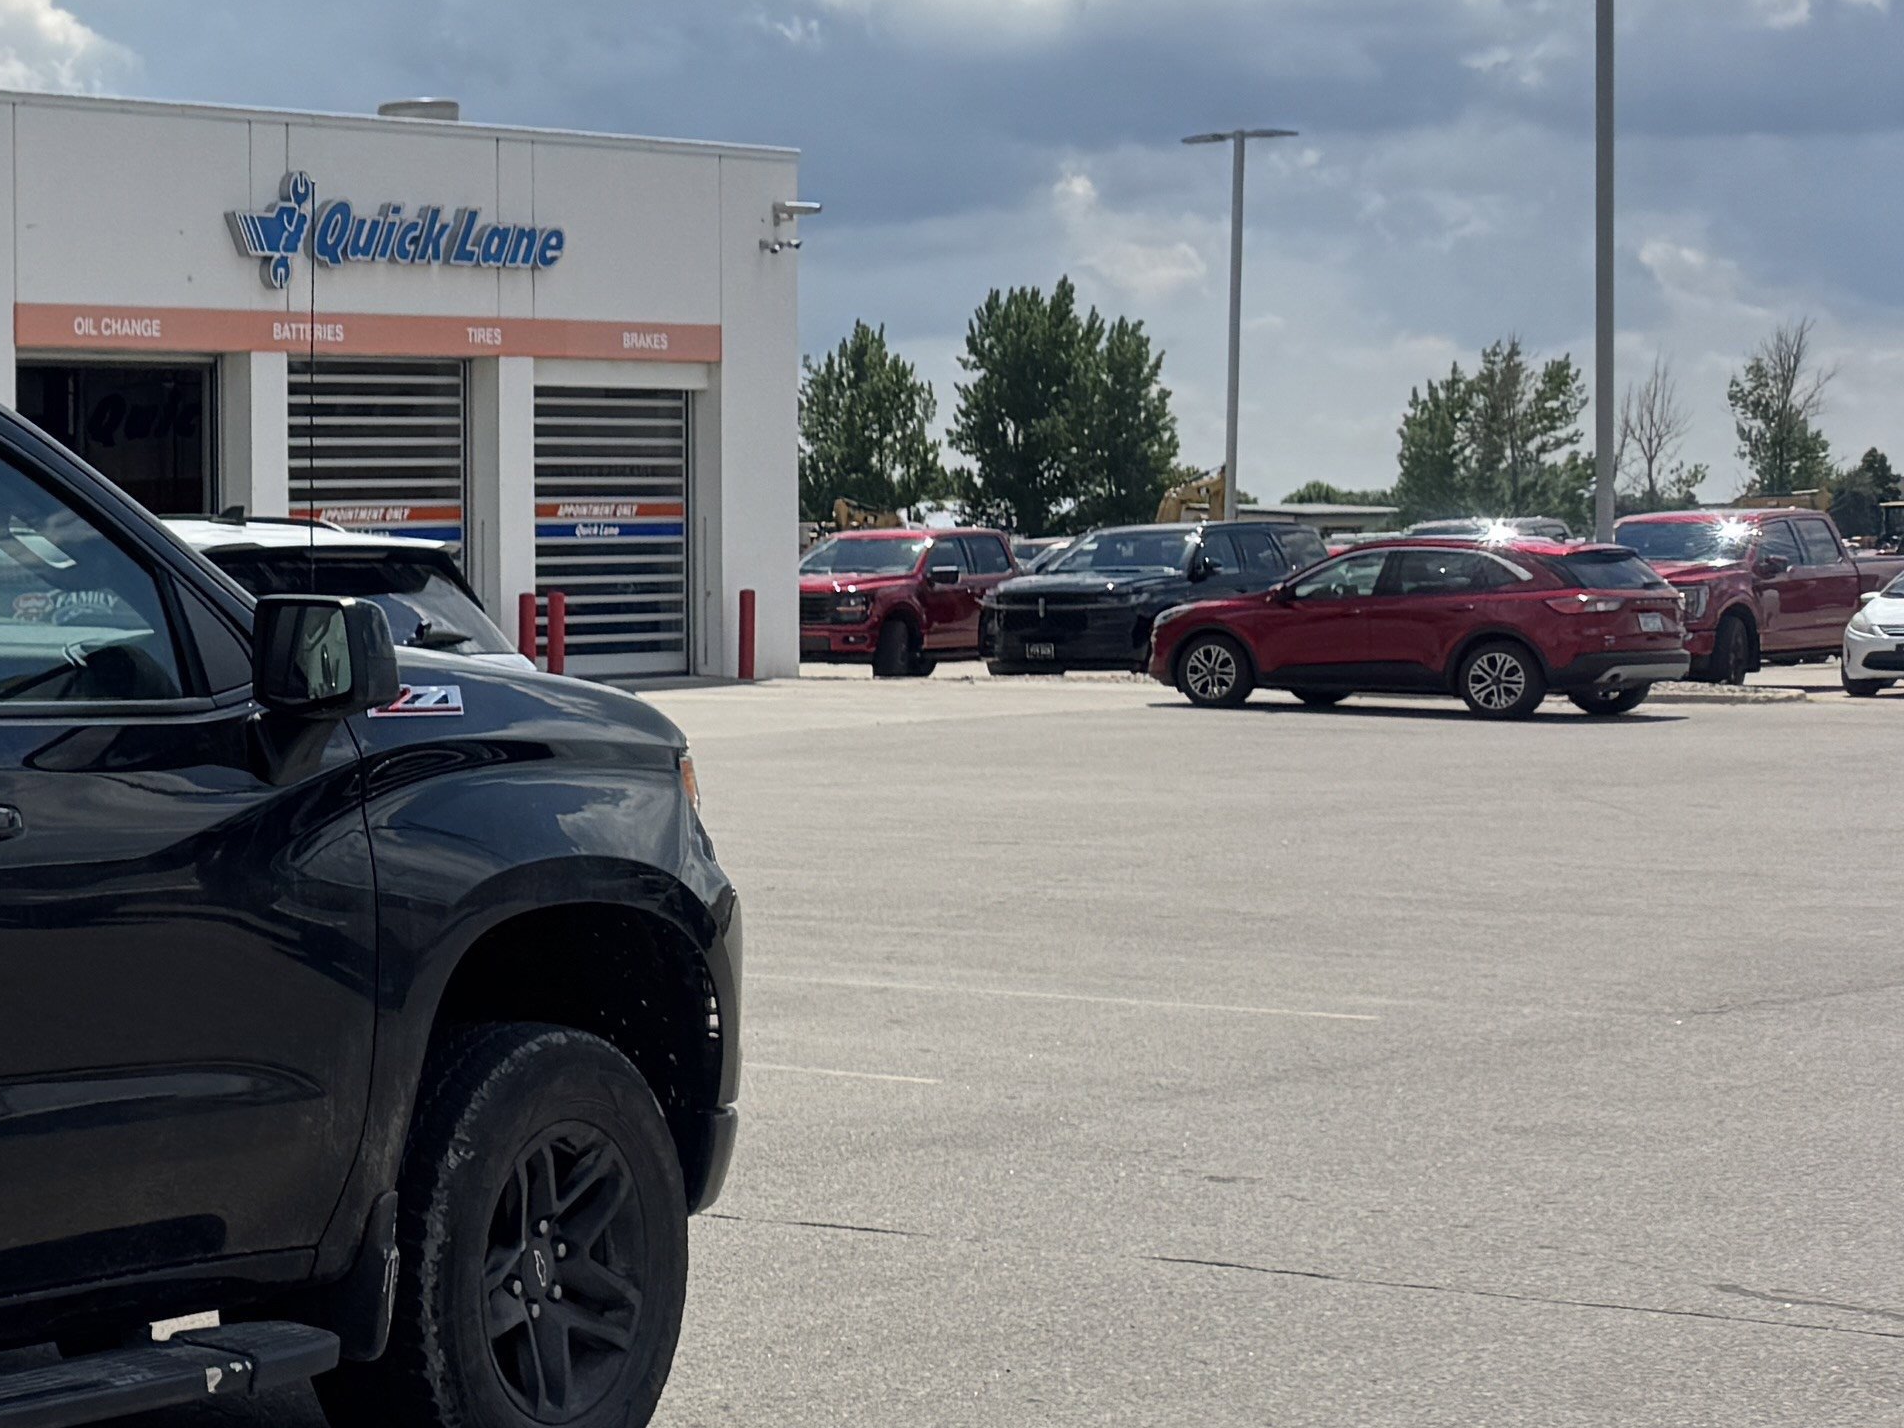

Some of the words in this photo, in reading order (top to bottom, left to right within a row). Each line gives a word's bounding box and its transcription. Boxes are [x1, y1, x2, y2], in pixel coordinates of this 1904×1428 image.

[313, 200, 453, 268] Quick
[449, 206, 565, 269] Lane
[73, 316, 98, 336] OIL
[101, 317, 162, 338] CHANGE
[273, 322, 345, 342] BATTERIES
[467, 327, 502, 346] TIRES
[622, 332, 669, 351] BRAKES
[319, 507, 385, 522] APPOINTMENT
[385, 507, 411, 522] ONLY
[557, 503, 616, 518] APPOINTMENT
[616, 503, 638, 518] ONLY
